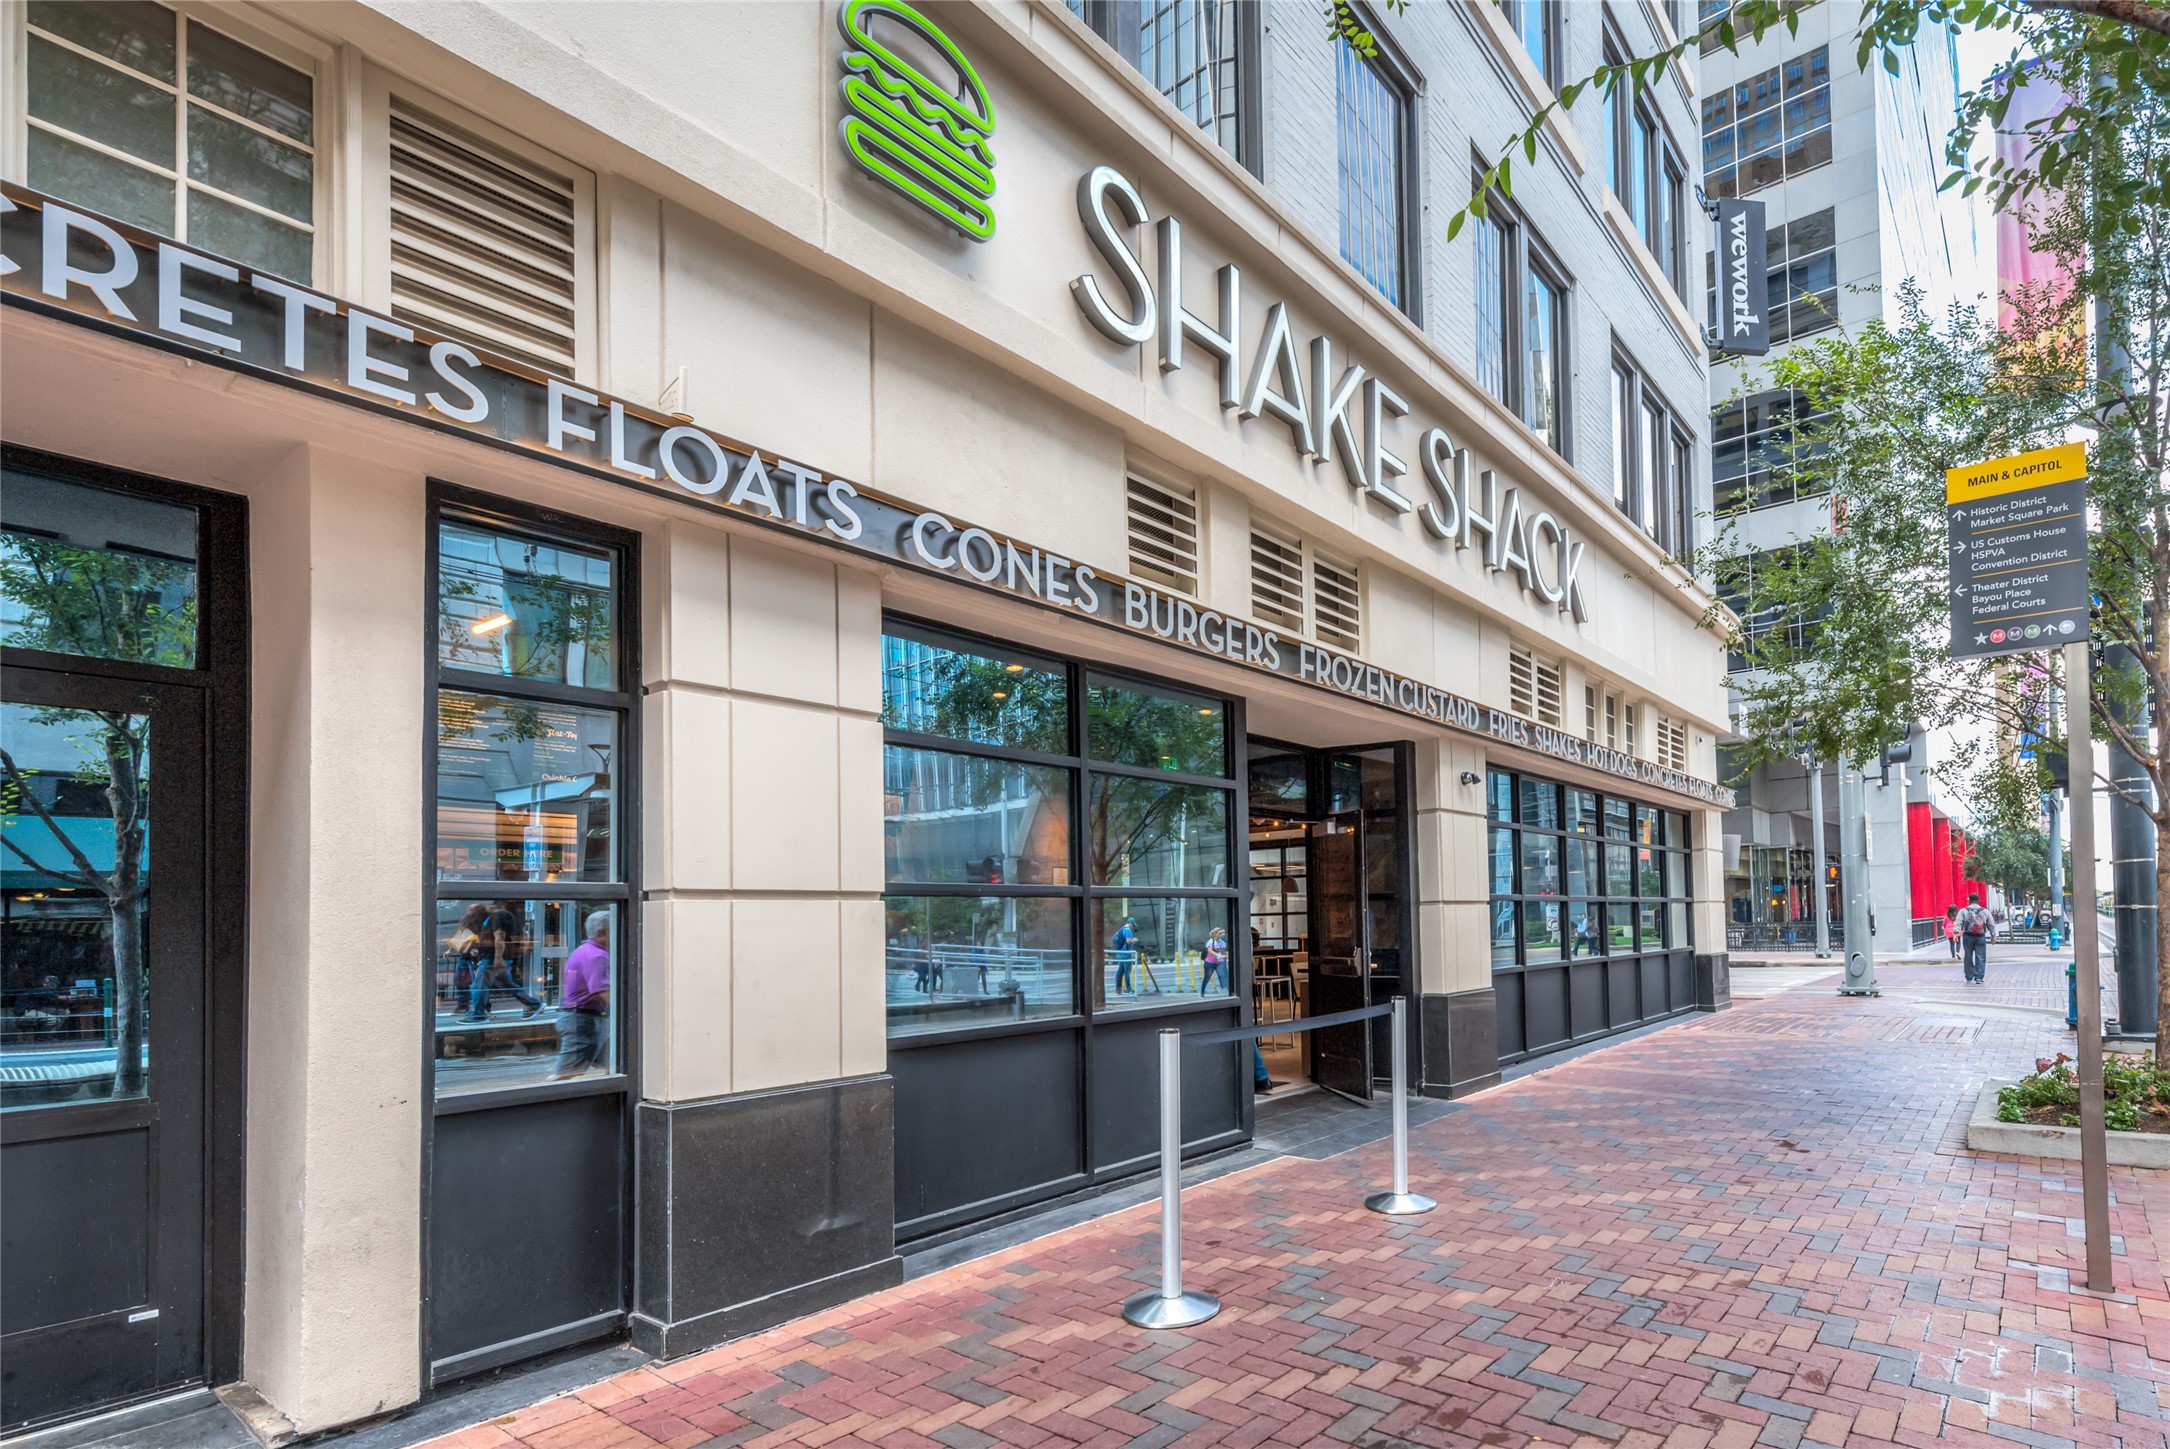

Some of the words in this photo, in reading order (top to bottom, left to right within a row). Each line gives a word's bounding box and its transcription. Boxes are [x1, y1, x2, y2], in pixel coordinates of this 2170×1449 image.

[1730, 210, 1760, 337] wework
[1069, 165, 1412, 514] SHAKE
[1418, 427, 1588, 623] SHACK
[1967, 472, 1999, 487] MAIN
[2001, 470, 2011, 480] &
[2013, 459, 2063, 478] CAPITOL
[0, 196, 489, 423] RETES
[548, 378, 863, 540] FLOATS
[912, 512, 1099, 614] CONES
[1125, 581, 1281, 671] BURGERS
[1300, 643, 1395, 706] FROZEN
[1398, 678, 1480, 731] CUSTARD
[1489, 709, 1529, 747] FRIES
[1535, 726, 1581, 762] SHAKES
[1587, 742, 1609, 769] HOT
[1610, 749, 1638, 778] DOGS
[1642, 761, 1688, 793] CONCRETES
[1690, 777, 1713, 801] FLOATS
[1970, 504, 2009, 517] Historic
[2010, 496, 2047, 509] District
[1970, 515, 2006, 528] Market
[2008, 509, 2044, 522] Square
[2046, 502, 2070, 515] Park
[1970, 539, 1986, 550] US
[1987, 533, 2031, 546] Customs
[2033, 525, 2067, 539] House
[1971, 547, 2006, 561] HSPVA
[1971, 556, 2028, 571] Convention
[2030, 548, 2068, 563] District
[1971, 580, 2010, 593] Theater
[2012, 573, 2049, 587] District
[1972, 591, 2004, 605] Bayou
[2005, 588, 2032, 600] Place
[1972, 602, 2010, 615] Federal
[2011, 597, 2046, 610] Courts
[479, 847, 521, 857] ORDER
